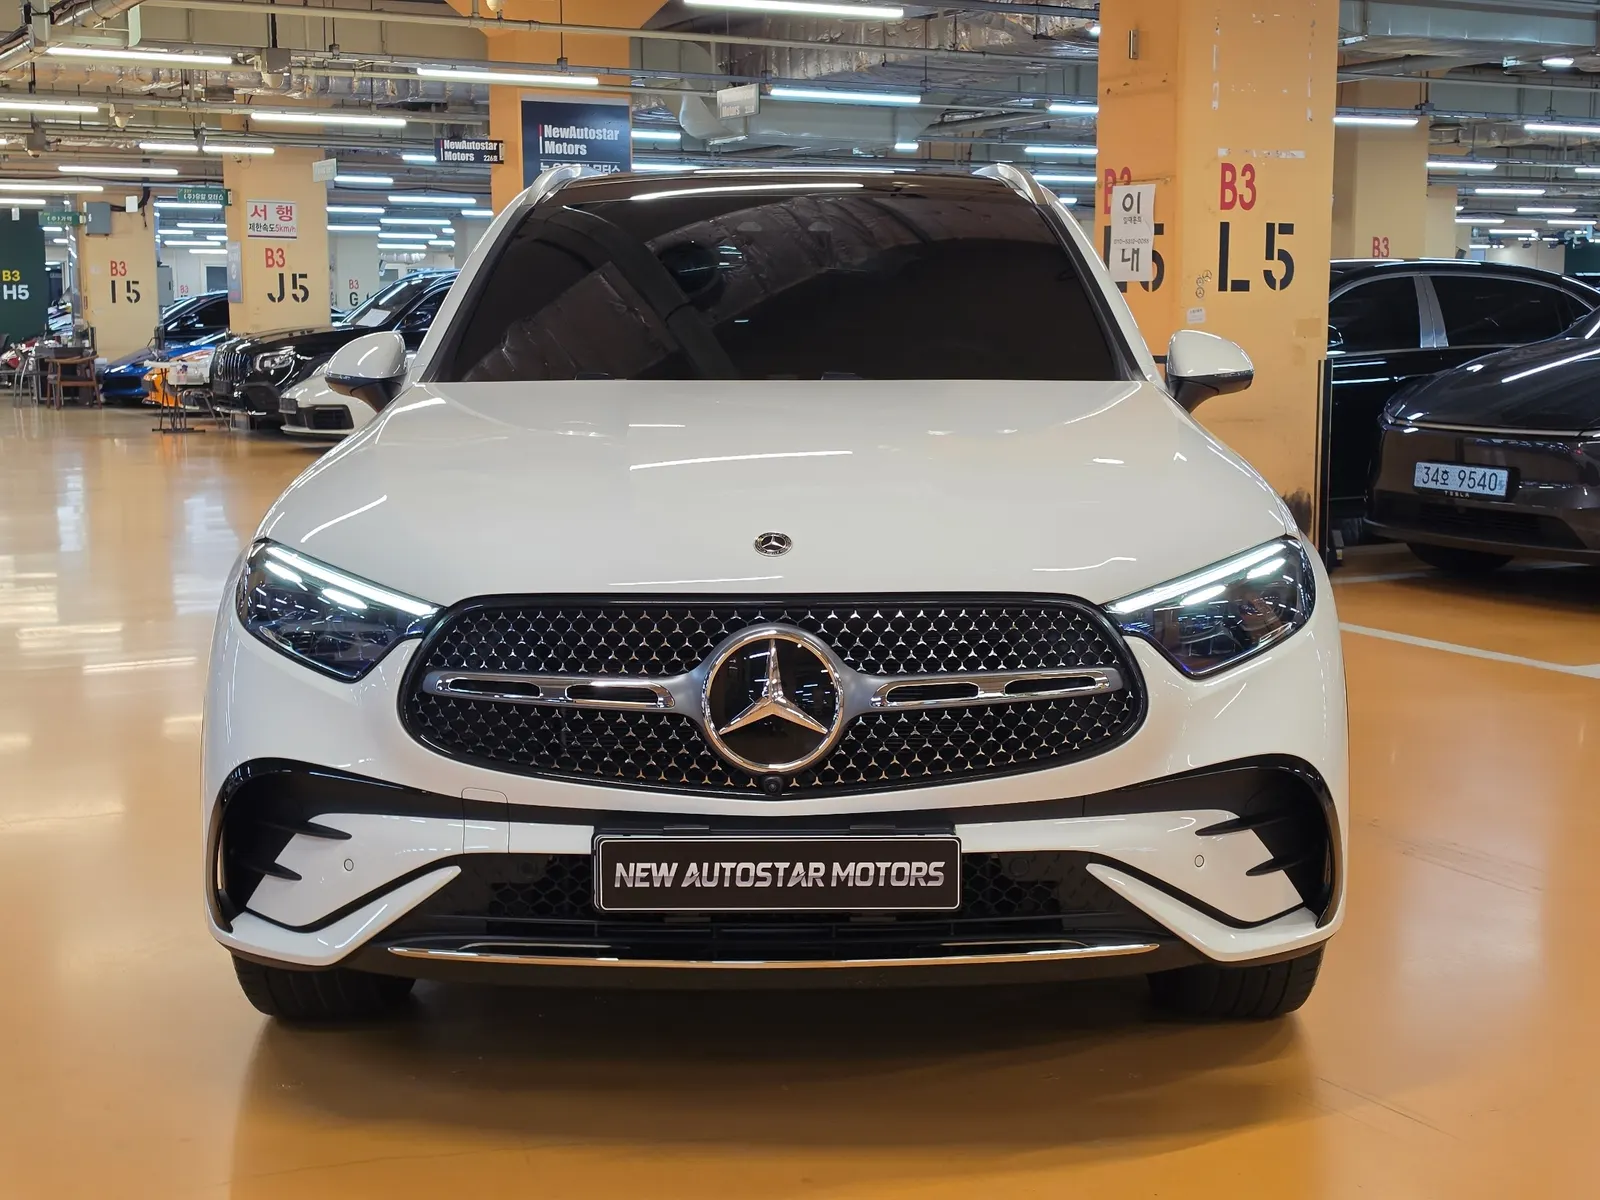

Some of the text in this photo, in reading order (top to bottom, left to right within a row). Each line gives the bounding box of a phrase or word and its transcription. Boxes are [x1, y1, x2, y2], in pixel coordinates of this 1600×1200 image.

[544, 124, 620, 140] NewAutostar
[443, 139, 498, 150] NewAutostar
[544, 140, 587, 155] Motors
[444, 151, 475, 161] Motors
[1220, 163, 1257, 211] B3
[1122, 191, 1141, 214] 이
[1372, 236, 1390, 258] B3
[265, 247, 286, 268] B3
[2, 270, 21, 282] B3
[110, 260, 127, 276] B3
[2, 284, 30, 300] H5
[267, 273, 310, 303] J5
[348, 279, 359, 290] B3
[1422, 466, 1498, 492] 34호 9540
[1444, 490, 1470, 498] TESLA
[614, 861, 945, 888] NEW AUTOSTAR MOTORS
